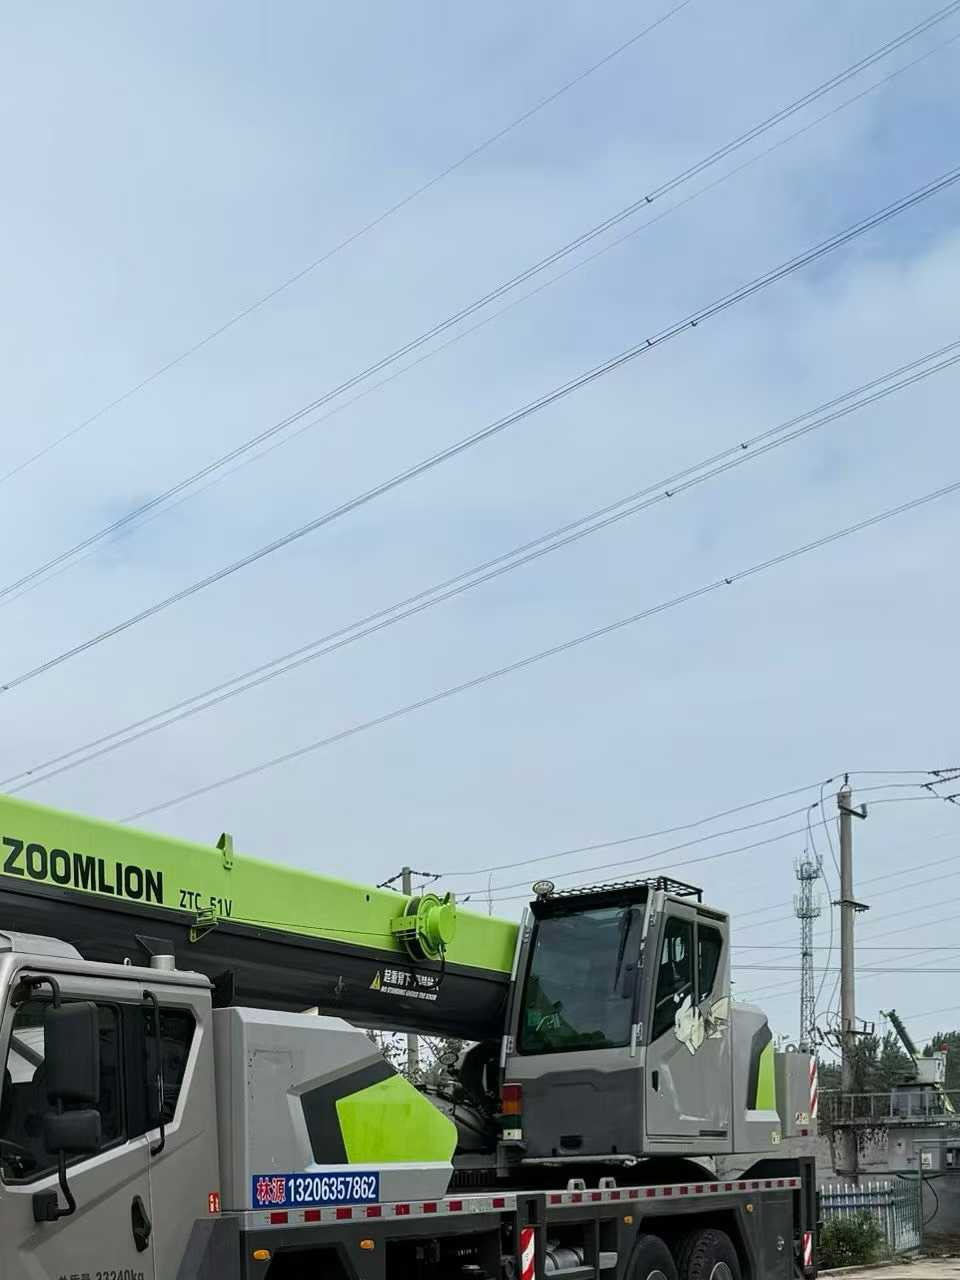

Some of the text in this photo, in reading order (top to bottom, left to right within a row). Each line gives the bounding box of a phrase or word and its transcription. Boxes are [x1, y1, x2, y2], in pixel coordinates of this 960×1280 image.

[2, 836, 164, 905] ZOOMLION
[256, 1176, 377, 1205] 林源 13206357862
